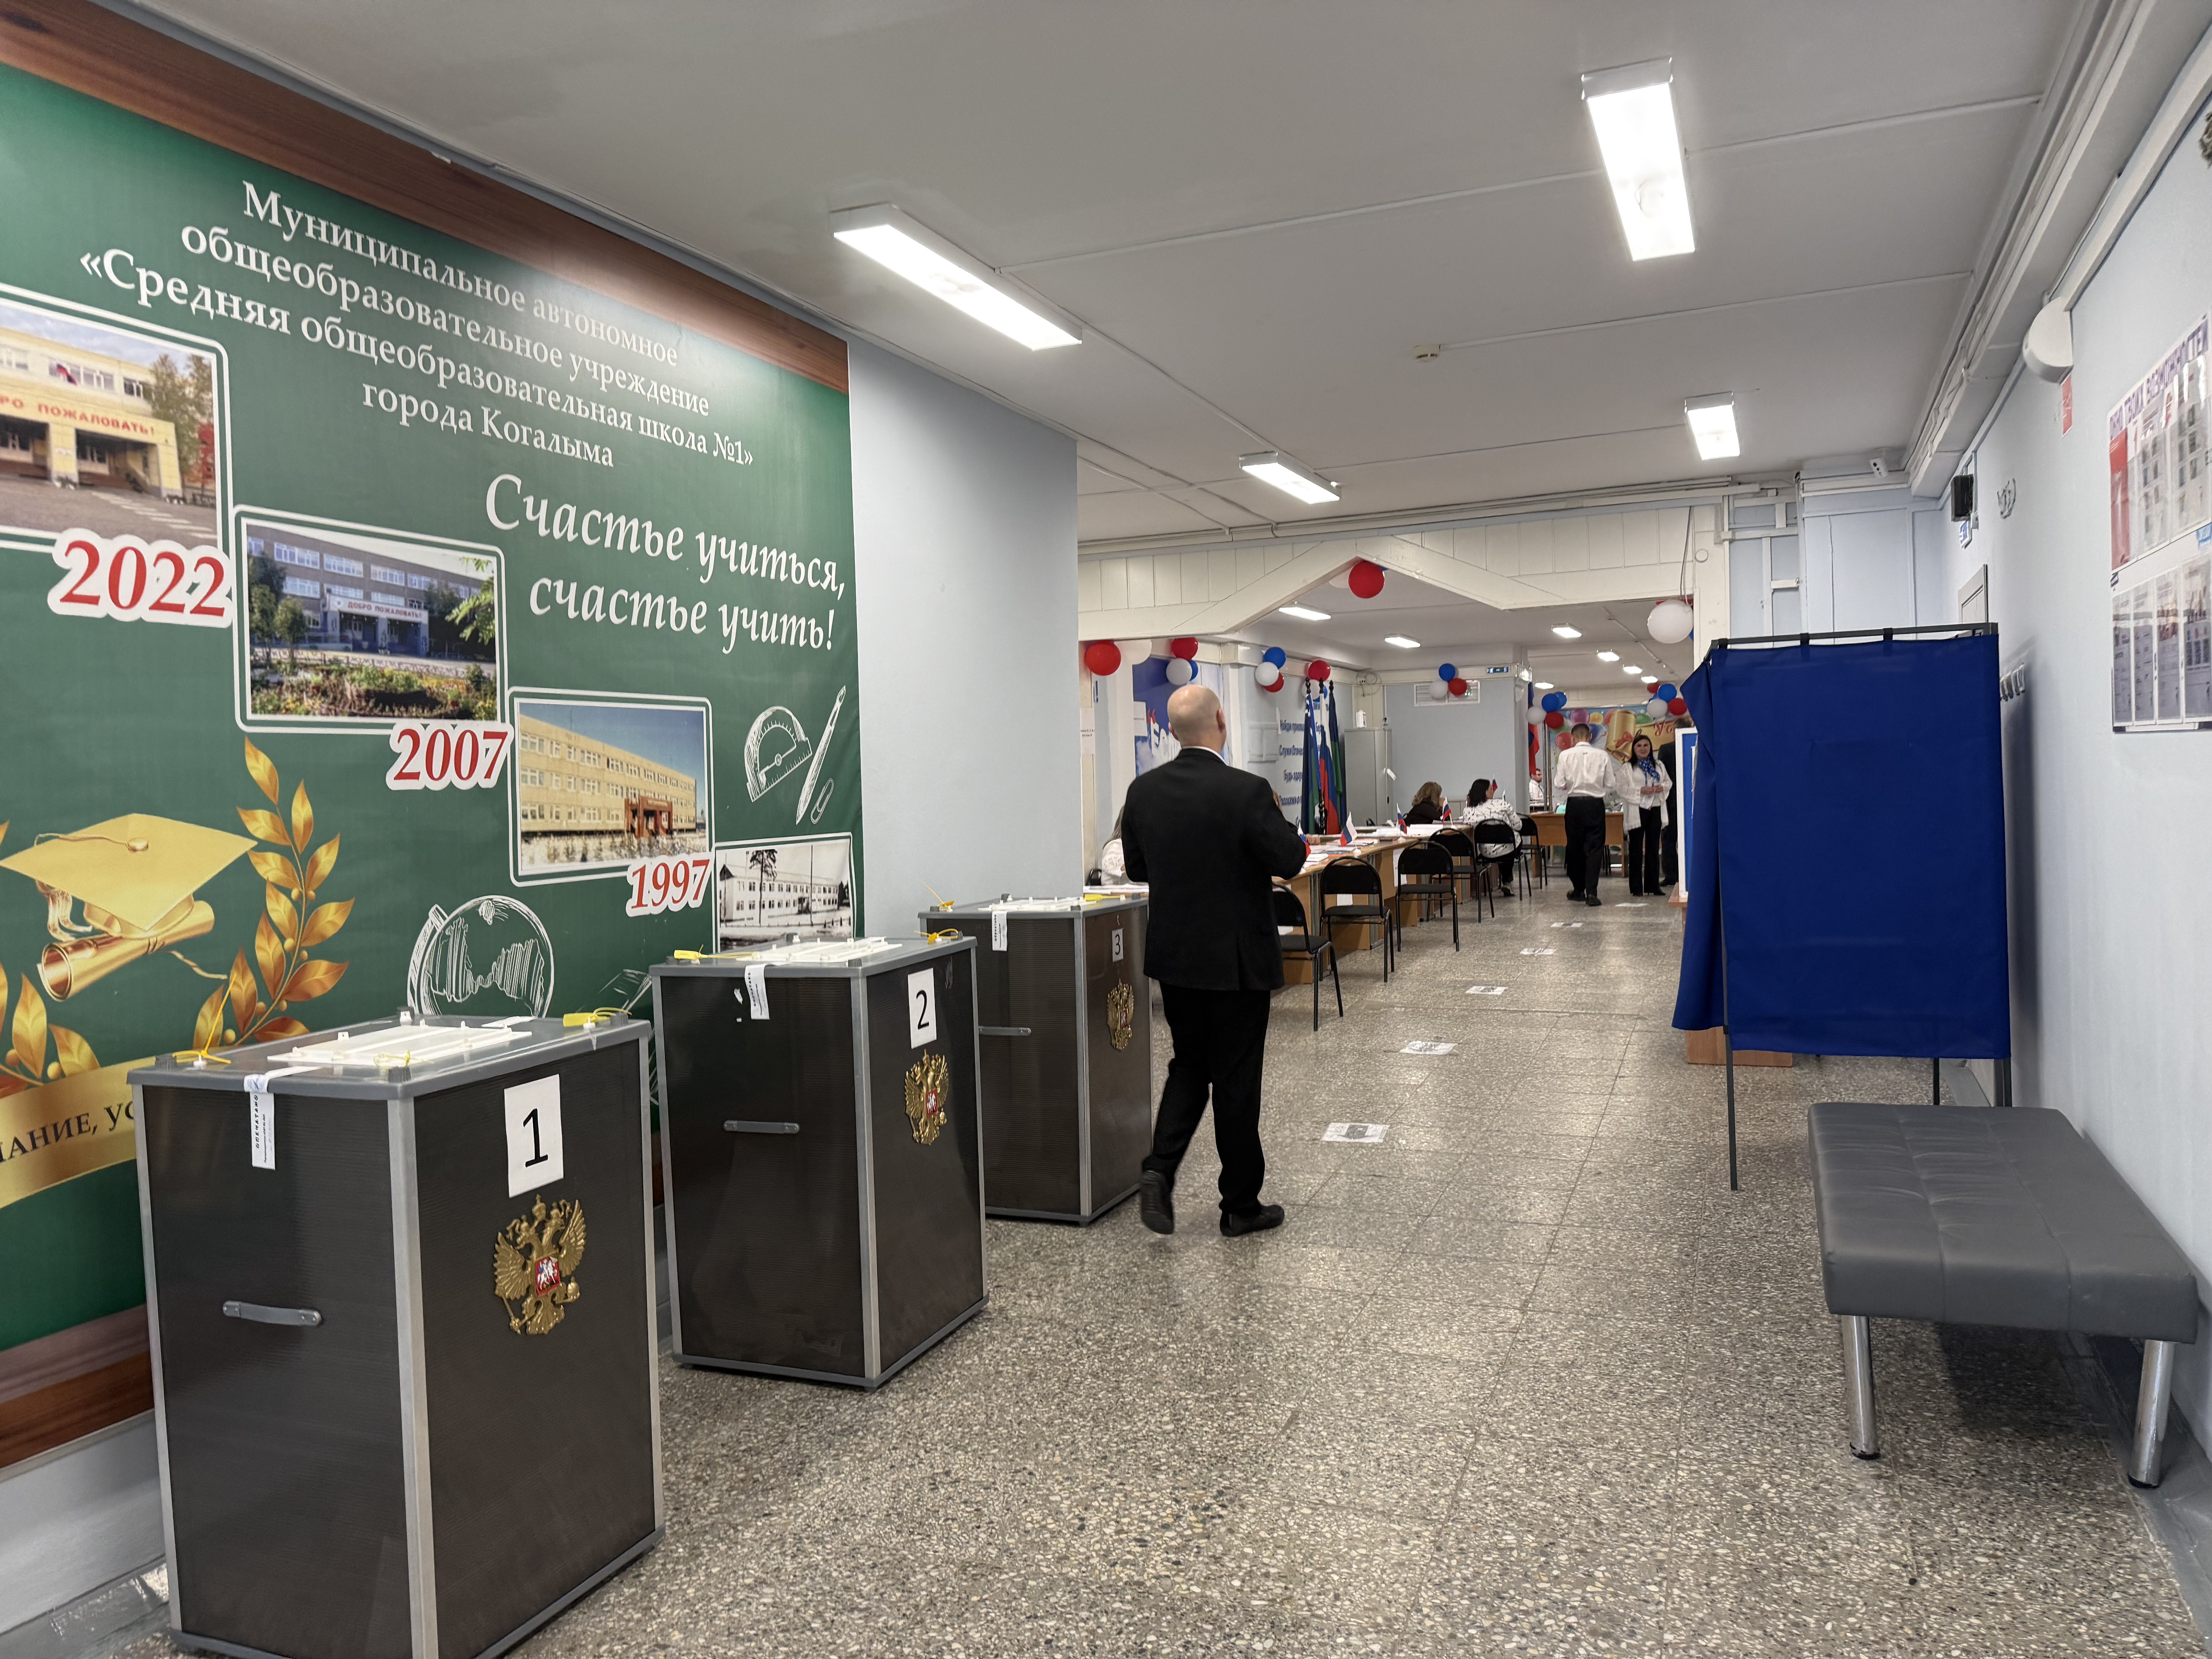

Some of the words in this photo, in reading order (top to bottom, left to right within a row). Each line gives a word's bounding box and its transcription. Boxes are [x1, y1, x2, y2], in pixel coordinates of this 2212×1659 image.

[242, 180, 525, 312] Муниципальное
[533, 299, 678, 366] автономное
[182, 226, 562, 368] общеобразовательное
[569, 352, 709, 416] учреждение
[80, 248, 291, 335] «Средняя
[301, 316, 633, 431] общеобразовательная
[638, 414, 708, 454] школа
[713, 432, 754, 465] №1»
[37, 402, 155, 436] ПОЖАЛОВАТЬ!
[362, 383, 474, 434] города
[481, 405, 614, 467] Когалыма
[486, 473, 684, 561] Счастье
[696, 531, 846, 601] учиться,
[60, 540, 225, 617] 2022
[348, 601, 371, 611] ДОБРО
[530, 577, 708, 634] счастье
[718, 603, 835, 654] учить!
[393, 727, 509, 781] 2007
[630, 858, 711, 910] 1997
[1115, 934, 1121, 955] 3
[915, 989, 929, 1030] 2
[523, 1108, 548, 1168] 1
